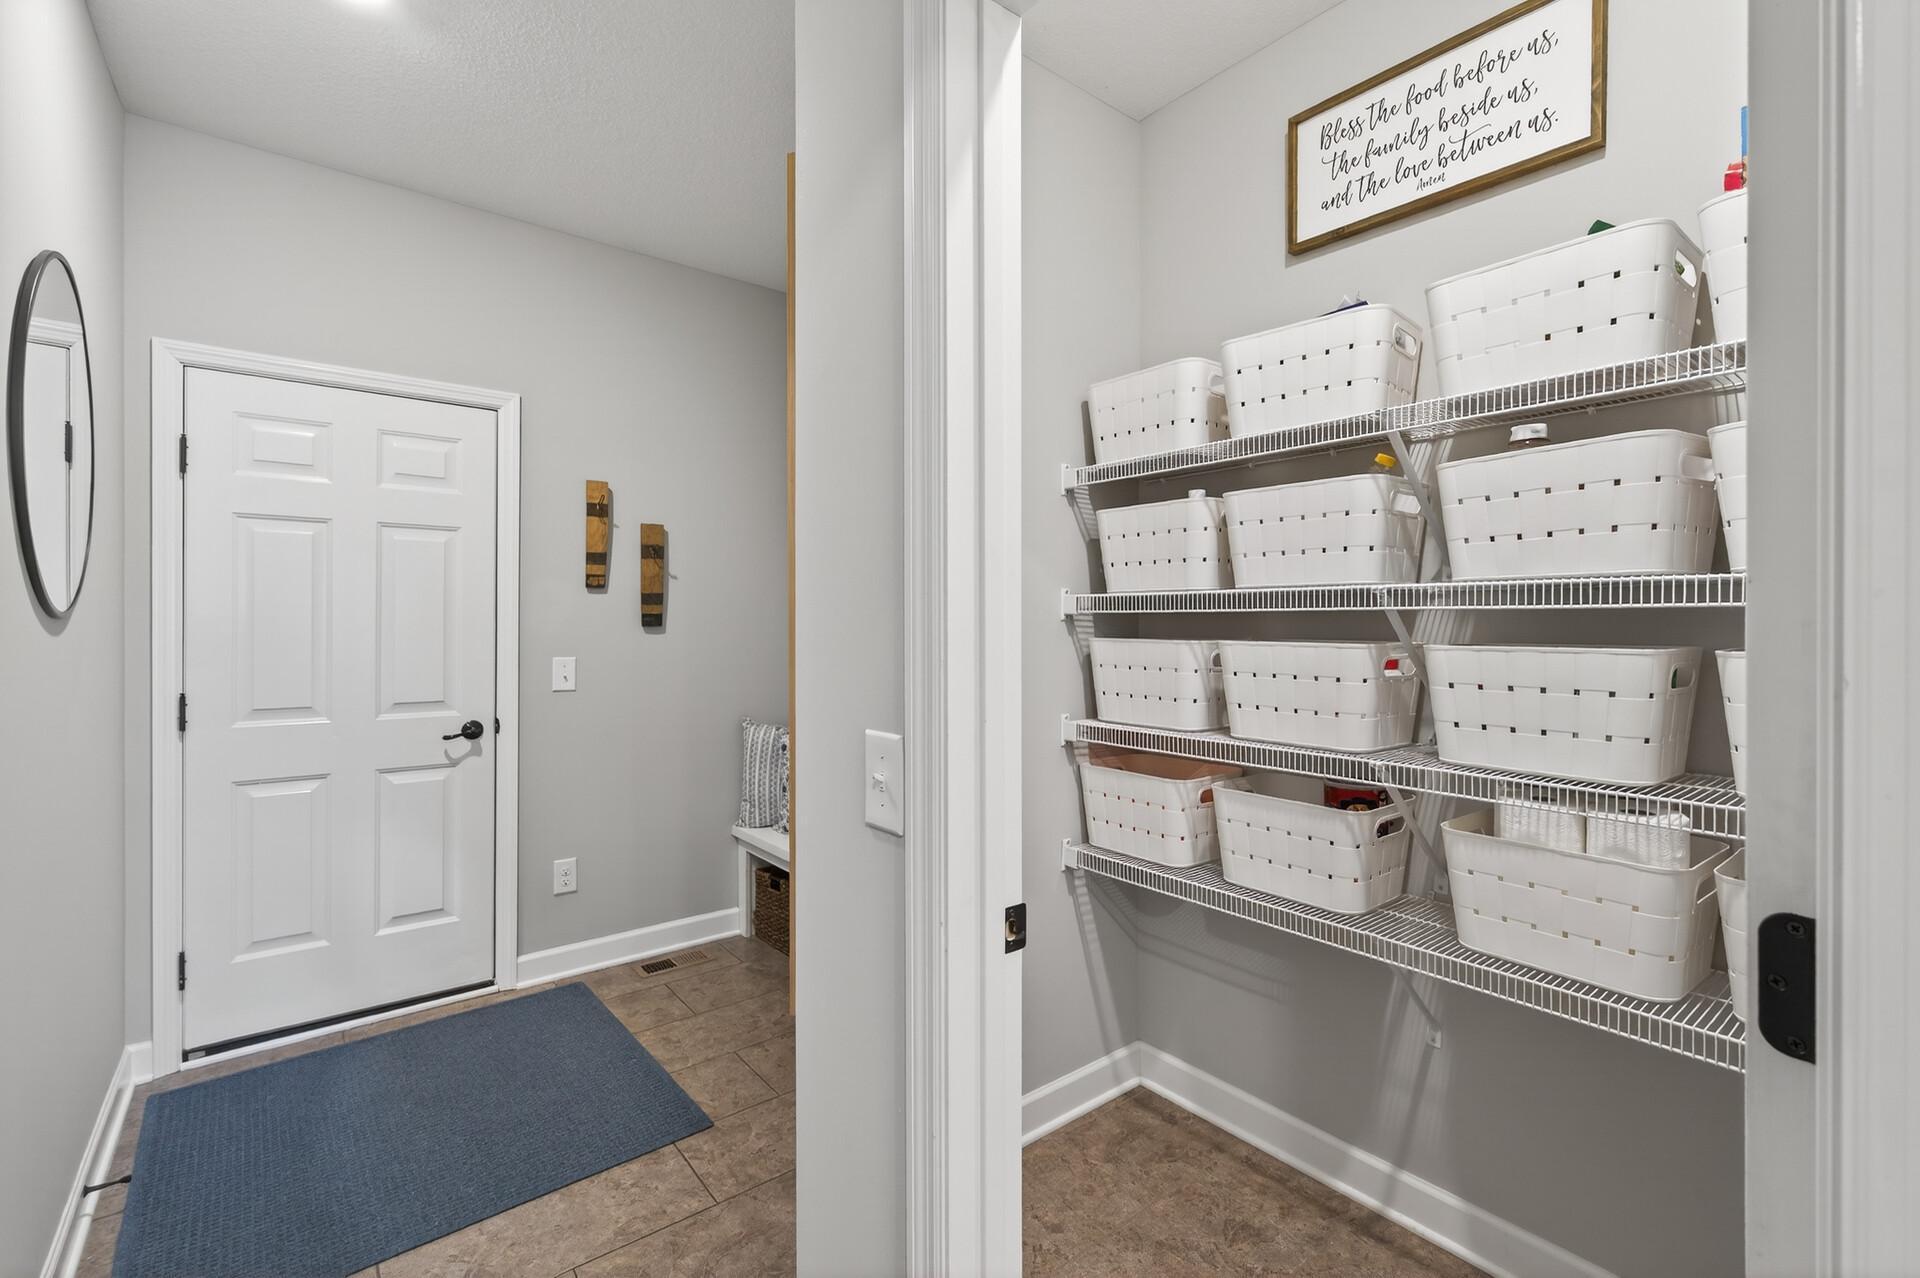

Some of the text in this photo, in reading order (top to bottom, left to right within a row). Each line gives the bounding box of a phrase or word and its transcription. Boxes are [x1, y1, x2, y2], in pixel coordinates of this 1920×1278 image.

[1320, 29, 1558, 150] Bless the food before us,
[1322, 78, 1538, 181] the family beside us,
[1321, 107, 1558, 211] and the love between us.
[1417, 173, 1446, 191] Amen
